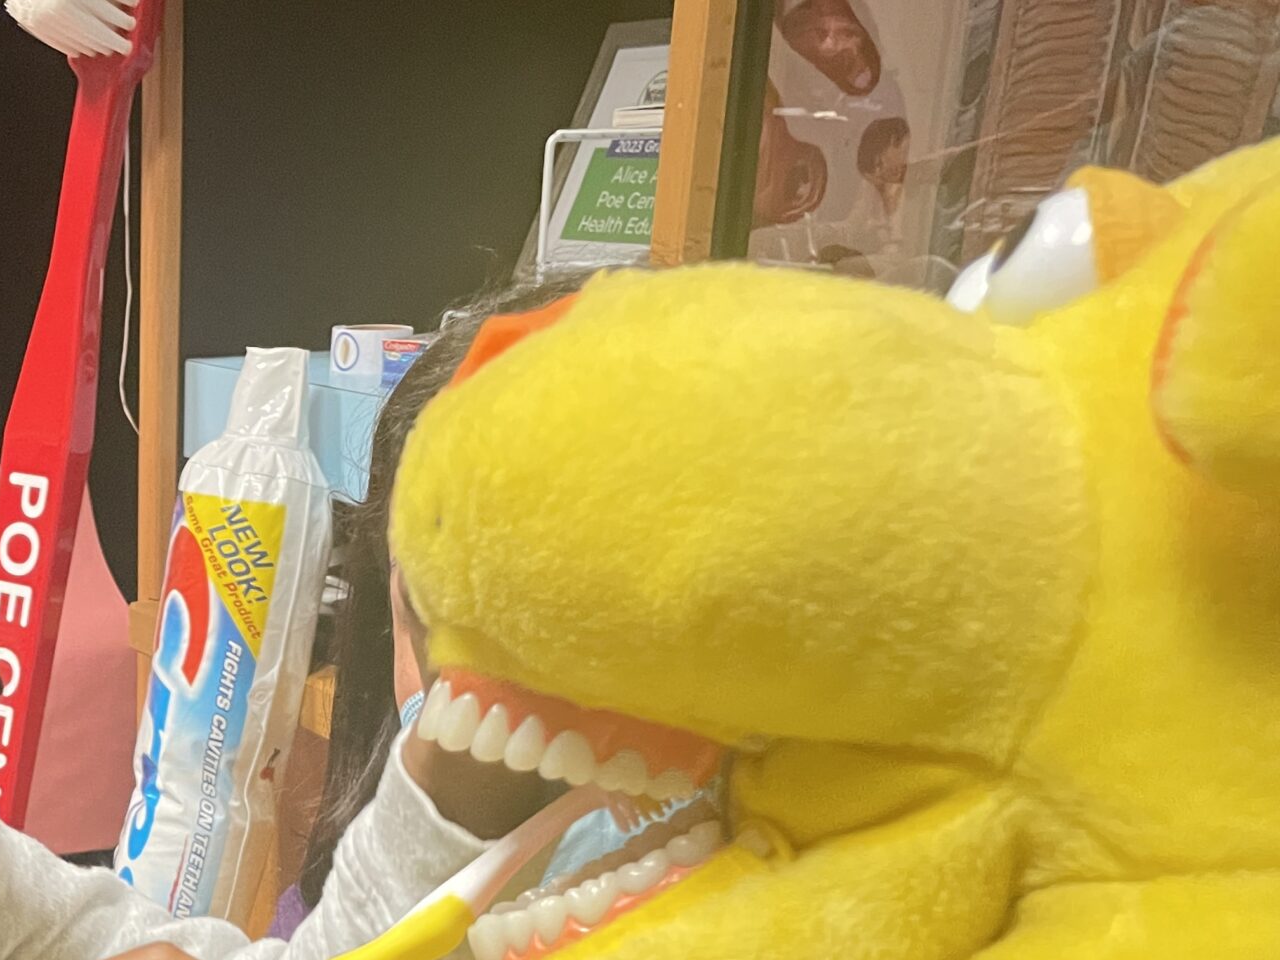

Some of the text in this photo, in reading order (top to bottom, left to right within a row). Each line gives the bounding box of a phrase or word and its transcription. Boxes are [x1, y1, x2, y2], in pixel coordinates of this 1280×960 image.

[611, 166, 648, 184] Alice
[615, 140, 643, 153] 2023
[577, 215, 652, 235] Health Edu
[596, 191, 655, 209] Poe Cen
[207, 525, 268, 605] LOOK!
[220, 502, 273, 570] NEW
[186, 495, 262, 641] Same Great Product
[215, 640, 243, 712] FIGHTS
[200, 712, 227, 798] CAVITIES
[195, 799, 216, 830] ON
[183, 833, 210, 891] TEETH
